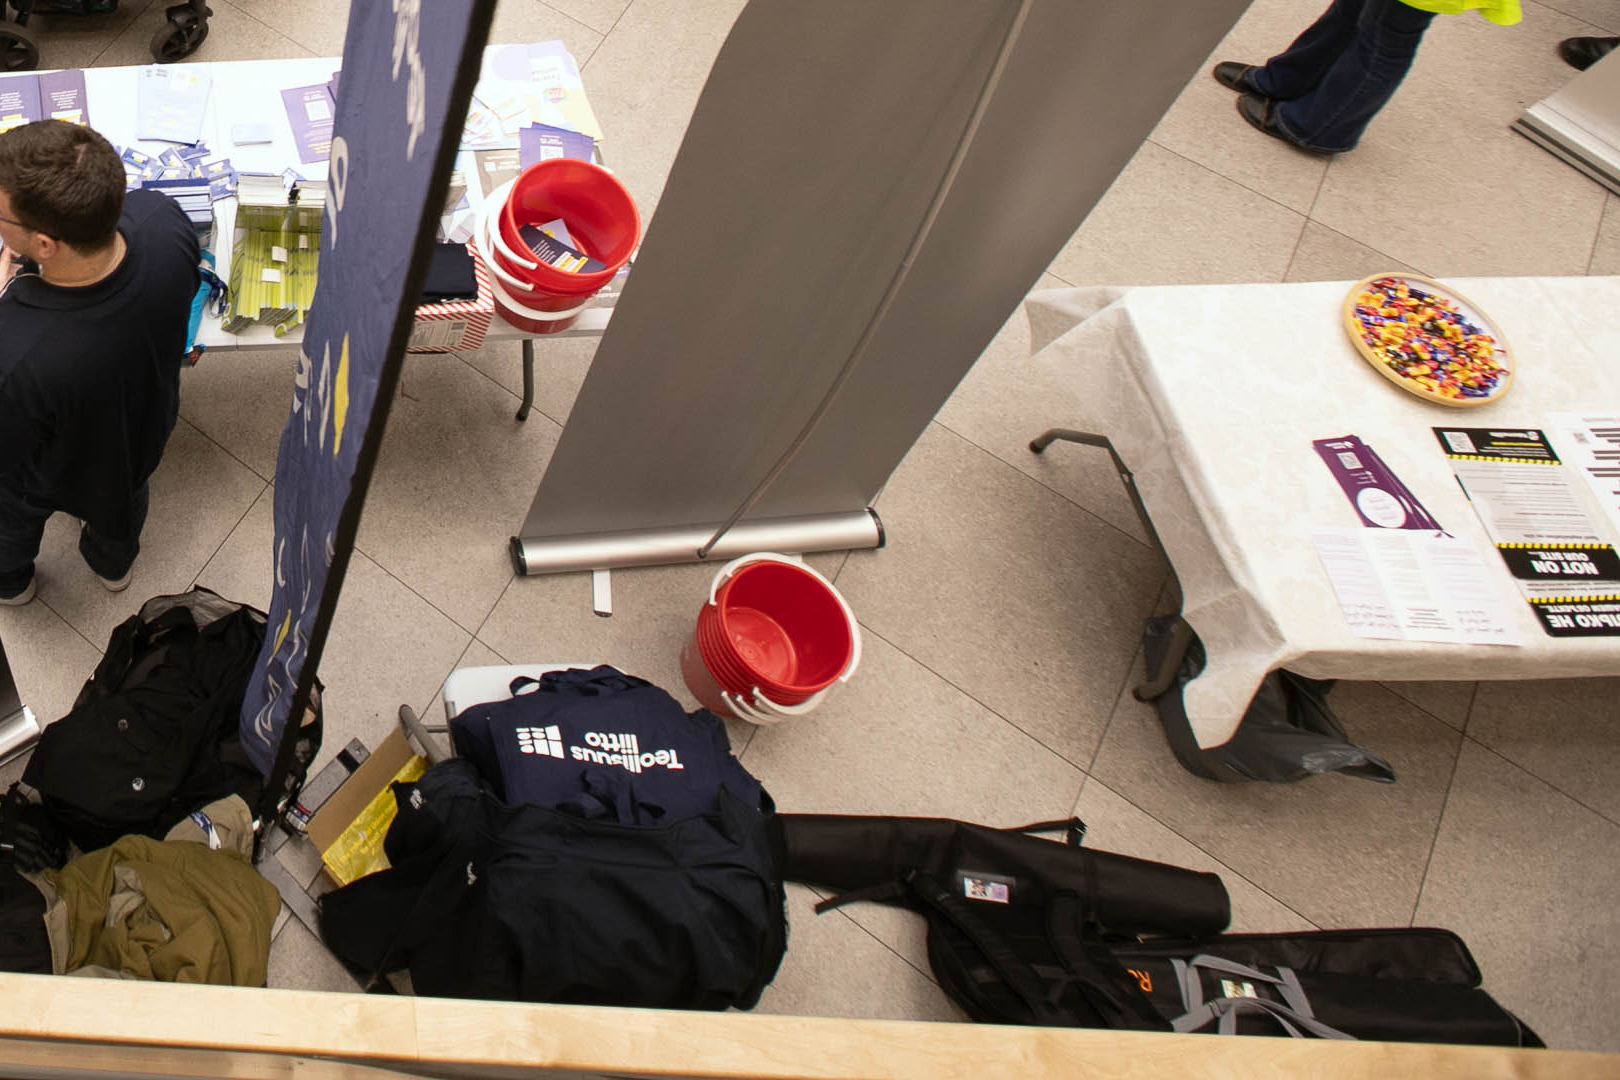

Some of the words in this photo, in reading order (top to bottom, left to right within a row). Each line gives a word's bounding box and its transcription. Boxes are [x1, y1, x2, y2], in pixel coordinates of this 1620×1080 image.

[1562, 552, 1590, 561] OUR
[1530, 560, 1561, 573] ON
[1561, 561, 1599, 575] NOT
[1545, 614, 1575, 628] НЕ
[584, 731, 640, 756] liitto
[570, 746, 684, 773] Teollisuus
